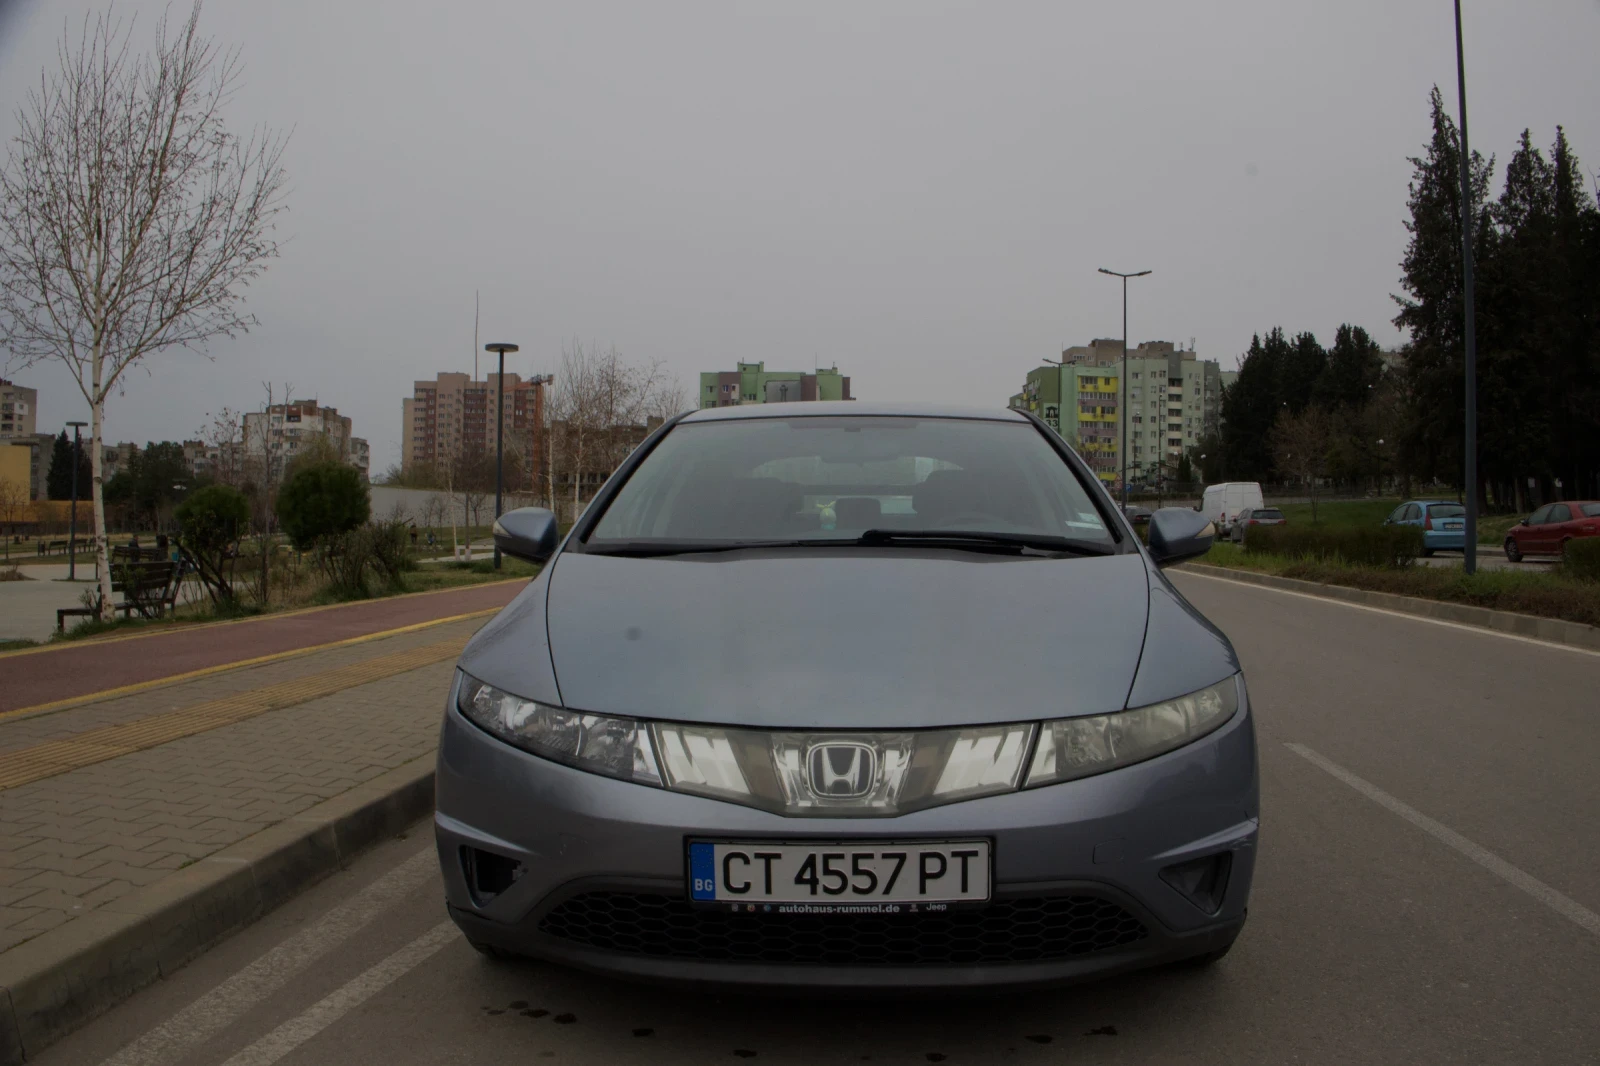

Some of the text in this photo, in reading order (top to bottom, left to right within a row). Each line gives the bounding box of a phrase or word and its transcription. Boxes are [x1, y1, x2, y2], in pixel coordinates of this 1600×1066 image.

[1046, 419, 1058, 427] 33
[723, 850, 979, 895] CT 4557 PT
[695, 879, 713, 891] BG
[779, 903, 947, 913] autohaus-rummel.de Jeep
